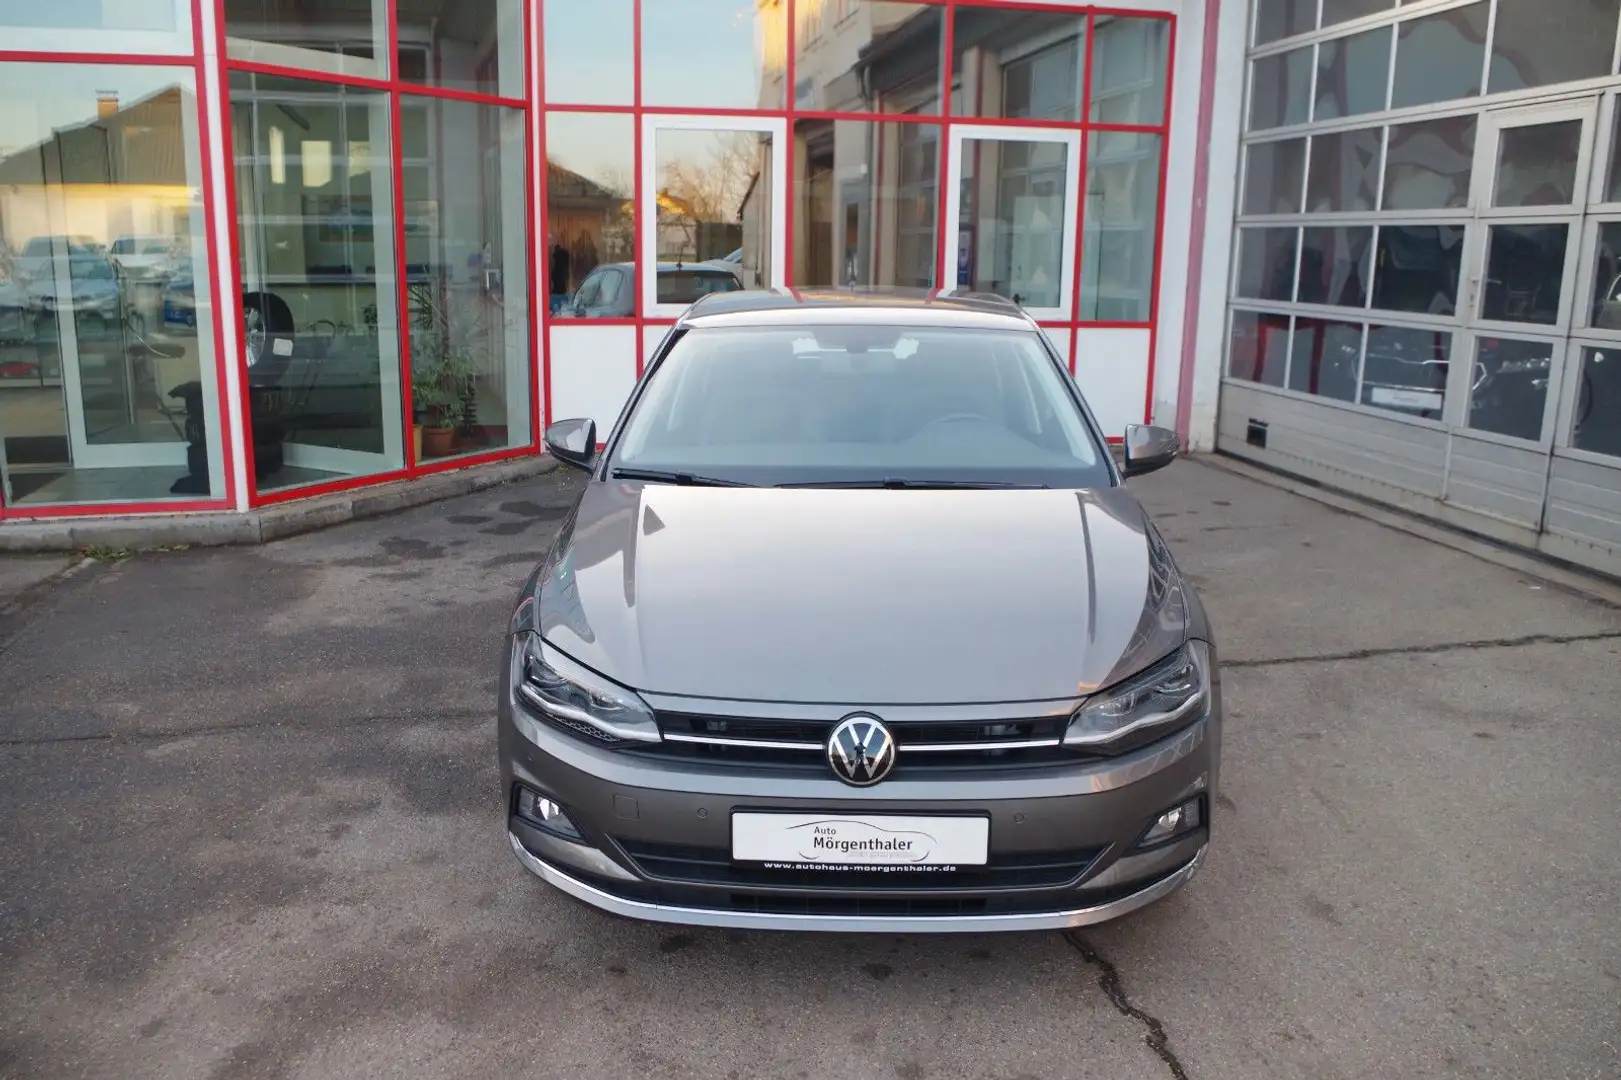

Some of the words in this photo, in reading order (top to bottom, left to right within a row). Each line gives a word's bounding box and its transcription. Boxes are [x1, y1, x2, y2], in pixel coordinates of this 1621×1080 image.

[814, 826, 836, 835] Auto
[813, 836, 913, 852] Mörgenthaler
[764, 862, 956, 872] www.autohaus-moergenthaler.de
